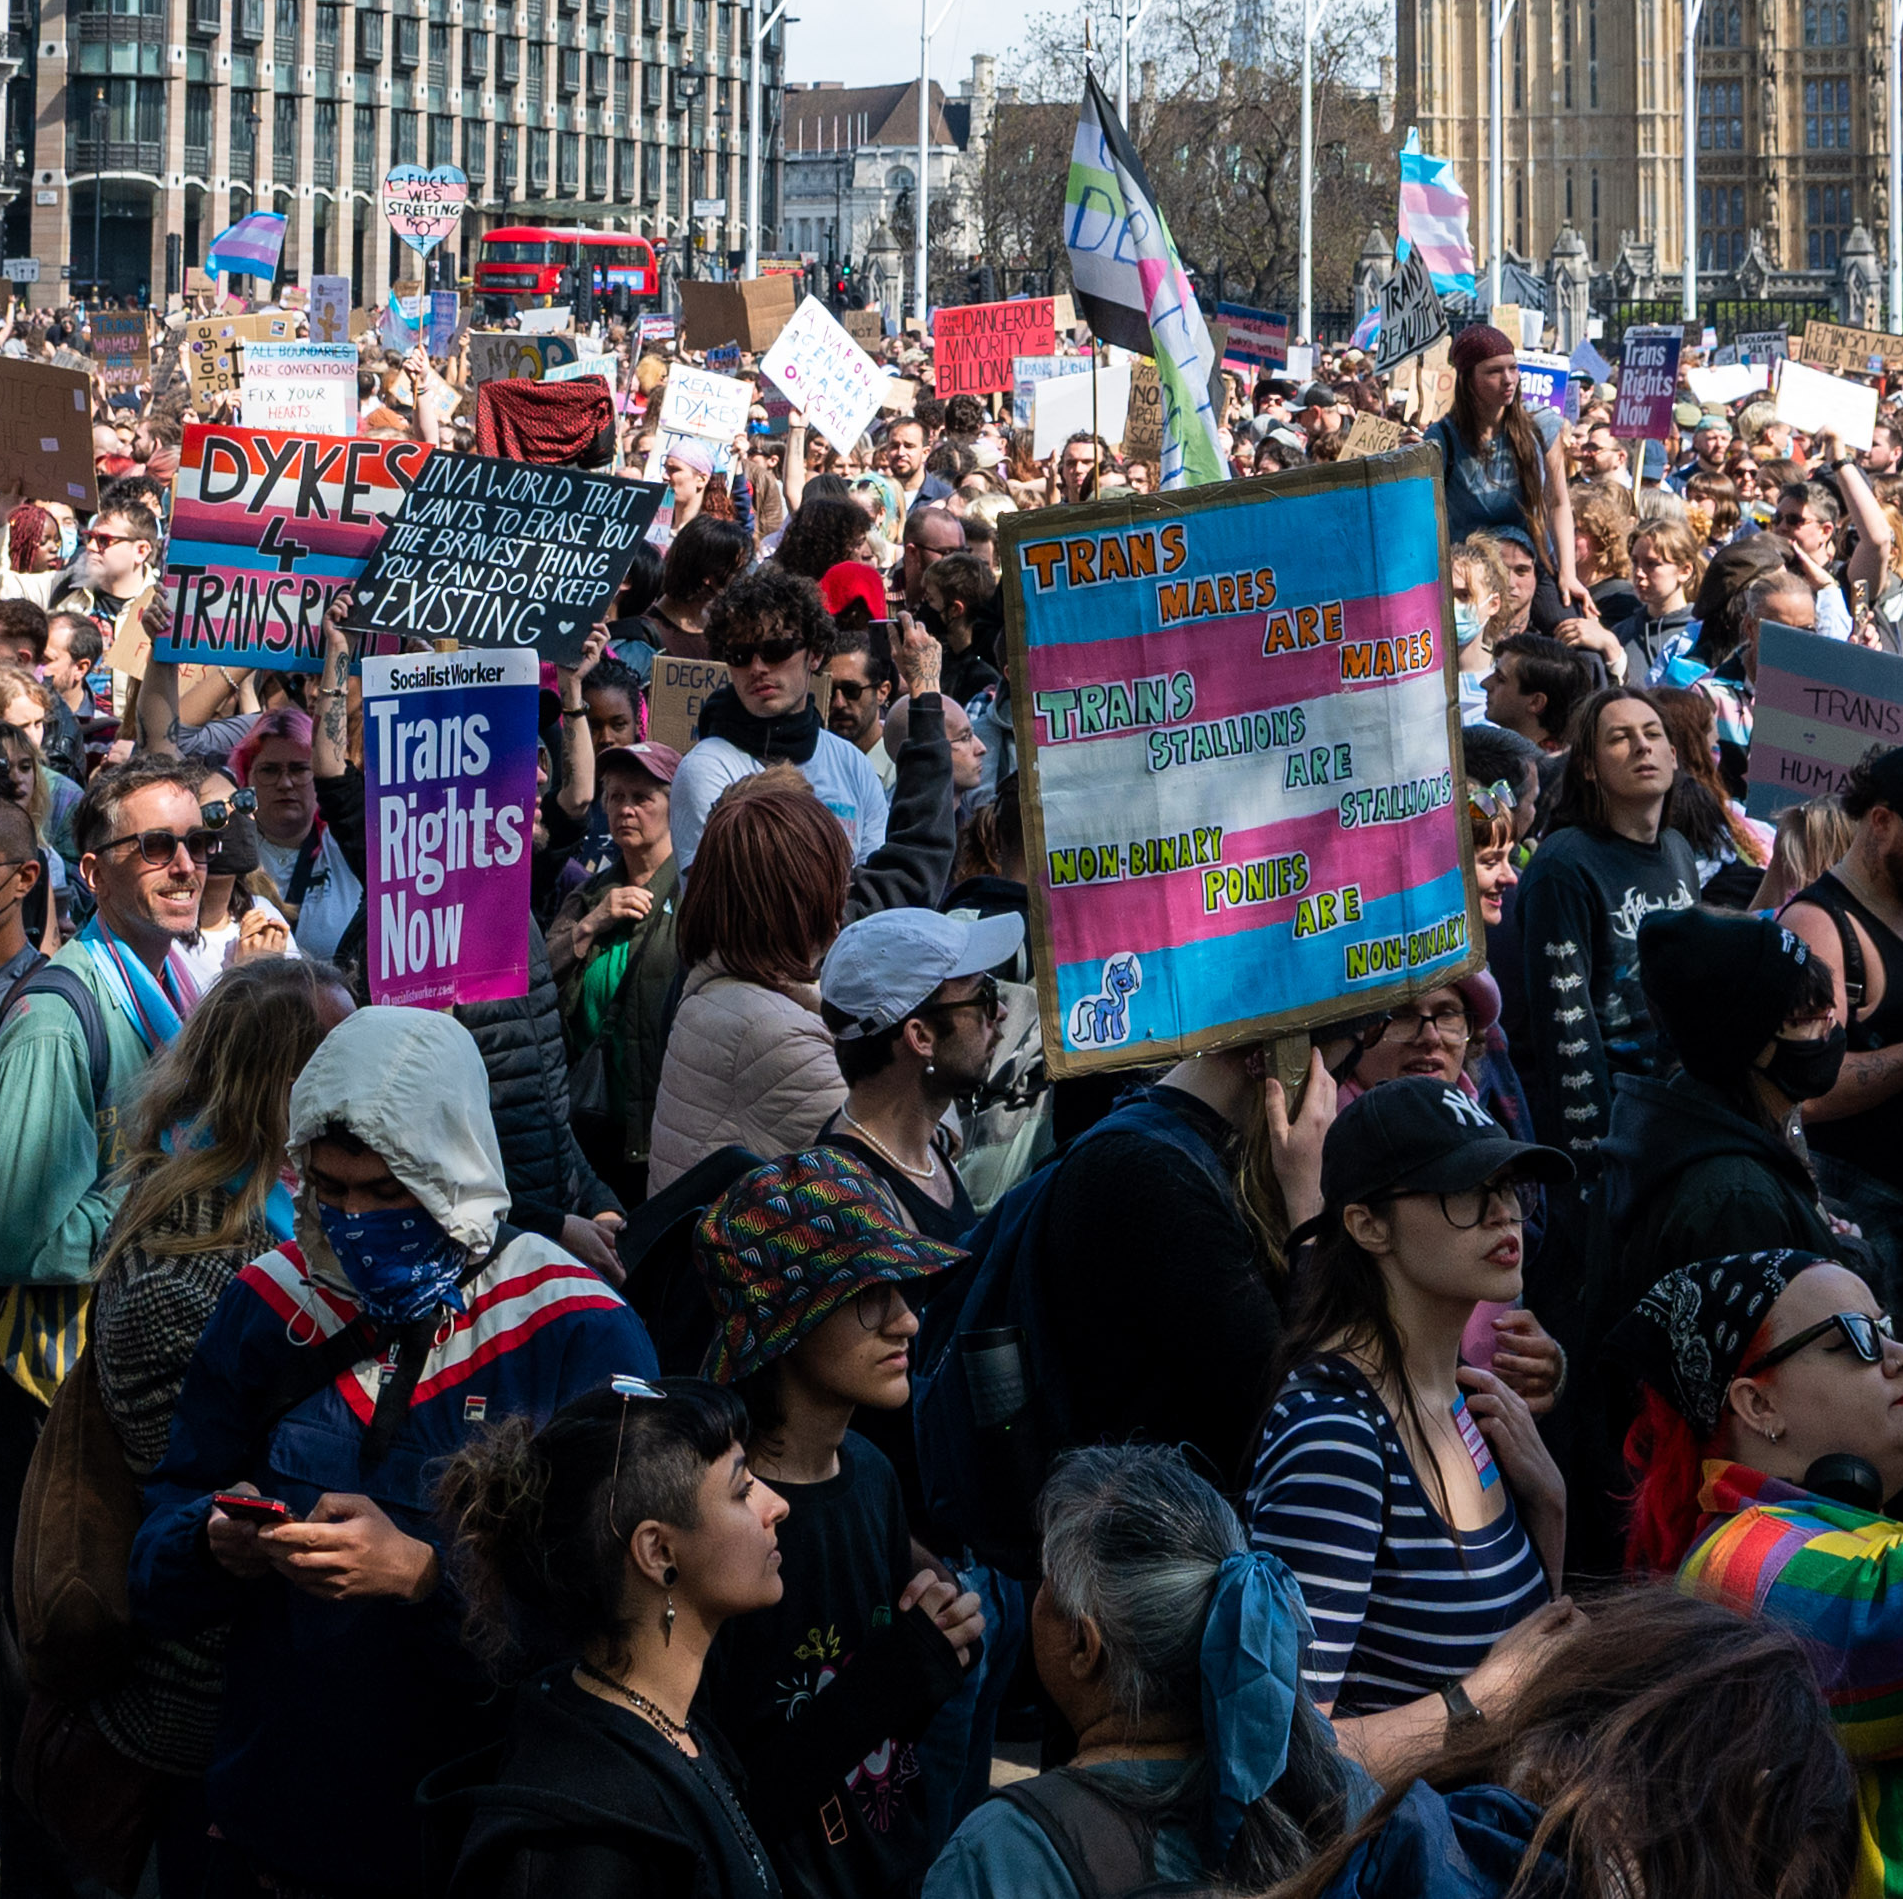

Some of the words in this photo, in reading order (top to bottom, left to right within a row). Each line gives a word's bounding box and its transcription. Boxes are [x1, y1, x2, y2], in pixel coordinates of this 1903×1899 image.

[408, 174, 449, 188] FUCK
[408, 189, 442, 202] WES
[388, 202, 460, 216] STREETING
[1381, 248, 1424, 320] TRANS
[94, 316, 144, 334] TRANS
[852, 328, 872, 338] NOT
[942, 315, 960, 324] THE
[962, 303, 1054, 336] DANGEROUS
[1807, 323, 1869, 350] FEMINISM
[93, 335, 141, 352] WOMEN
[251, 345, 273, 358] ALL
[279, 345, 349, 358] BOUNDARIES
[945, 333, 1026, 362] MINORITY
[1036, 336, 1048, 346] IS
[1623, 339, 1666, 367] Trans
[1801, 343, 1839, 367] INCLUDE
[248, 363, 272, 376] ARE
[278, 363, 355, 376] CONVENTIONS
[677, 373, 730, 400] REAL
[784, 365, 806, 390] ON
[807, 389, 826, 412] US
[1016, 360, 1052, 376] TRANS
[1621, 369, 1673, 401] Rights
[247, 388, 276, 401] FIX
[287, 386, 326, 400] YOUR
[268, 405, 311, 419] HEARTS
[675, 396, 741, 425] DYKES
[1616, 399, 1651, 426] Now
[689, 414, 706, 427] 4
[1357, 413, 1369, 426] IF
[199, 436, 421, 530] DYKES
[418, 456, 464, 493] IN
[463, 463, 482, 496] A
[485, 465, 573, 507] WORLD
[582, 480, 650, 518] THAT
[404, 492, 485, 530] WANTS
[493, 506, 522, 535] TO
[521, 508, 596, 546] ERASE
[597, 517, 640, 551] YOU
[258, 517, 309, 573] 4
[389, 522, 426, 553] THE
[429, 527, 536, 569] BRAVEST
[536, 543, 610, 577] THING
[1023, 524, 1187, 589] TRANS
[375, 551, 422, 579] YOU
[427, 560, 485, 588] CAN
[487, 567, 528, 595] DO
[529, 573, 553, 600] IS
[552, 577, 610, 608] KEEP
[1158, 568, 1278, 625] MARES
[370, 578, 545, 645] EXISTING
[1264, 601, 1344, 655] ARE
[390, 664, 451, 691] Socialist
[451, 661, 506, 685] Worker
[1341, 630, 1434, 680] MARES
[1037, 671, 1195, 742] TRANS
[1803, 686, 1901, 736] TRANS
[370, 699, 491, 786] Trans
[1149, 707, 1307, 772] STALLIONS
[1286, 743, 1353, 788] ARE
[1341, 771, 1453, 829] STALLIONS
[379, 786, 525, 897] Rights
[1049, 827, 1224, 886] NON-BINARY
[1205, 852, 1311, 912] PONIES
[1295, 885, 1362, 939] ARE
[380, 890, 465, 981] Now
[1346, 915, 1466, 981] NON-BINARY
